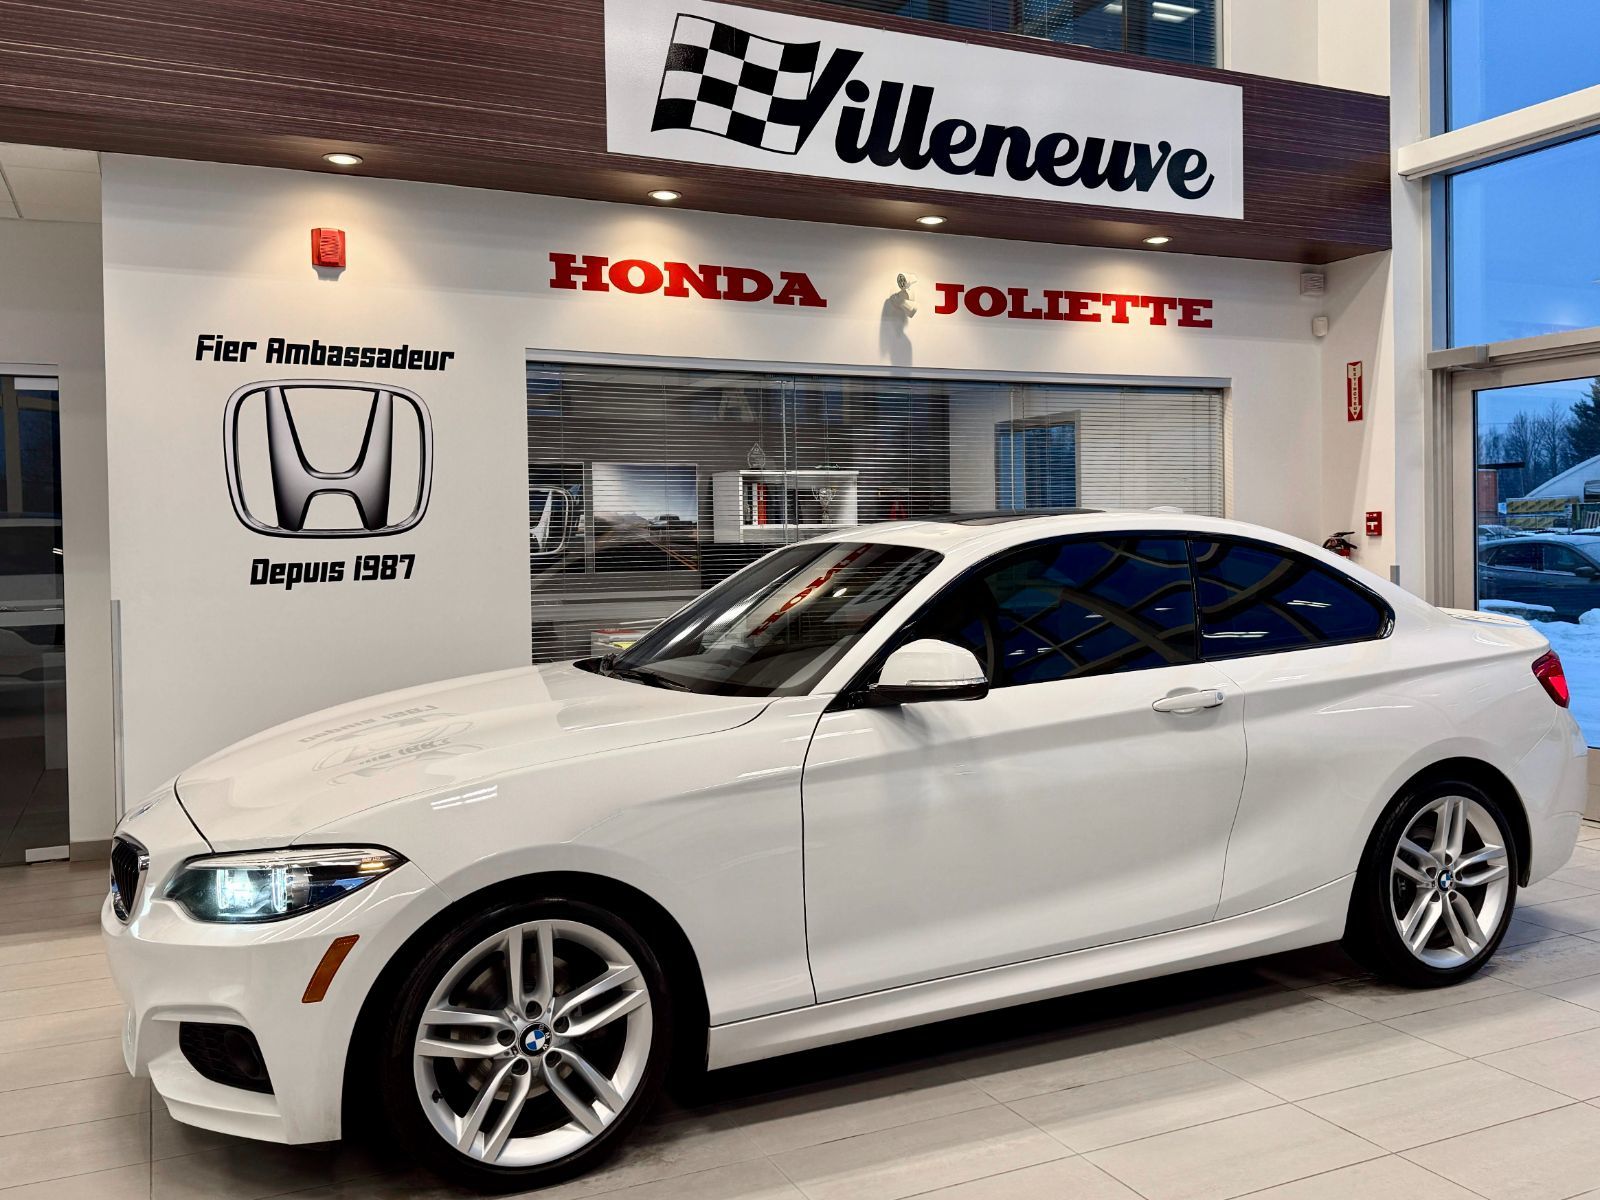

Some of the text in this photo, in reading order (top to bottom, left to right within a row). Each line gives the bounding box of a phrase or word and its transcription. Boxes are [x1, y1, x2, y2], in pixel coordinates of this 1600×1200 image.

[797, 48, 1214, 200] Villeneuve
[549, 252, 827, 308] HONDA
[935, 282, 1213, 328] JOLIETTE
[195, 334, 455, 371] Fier Ambassadeur
[250, 553, 416, 591] Depuis 1987
